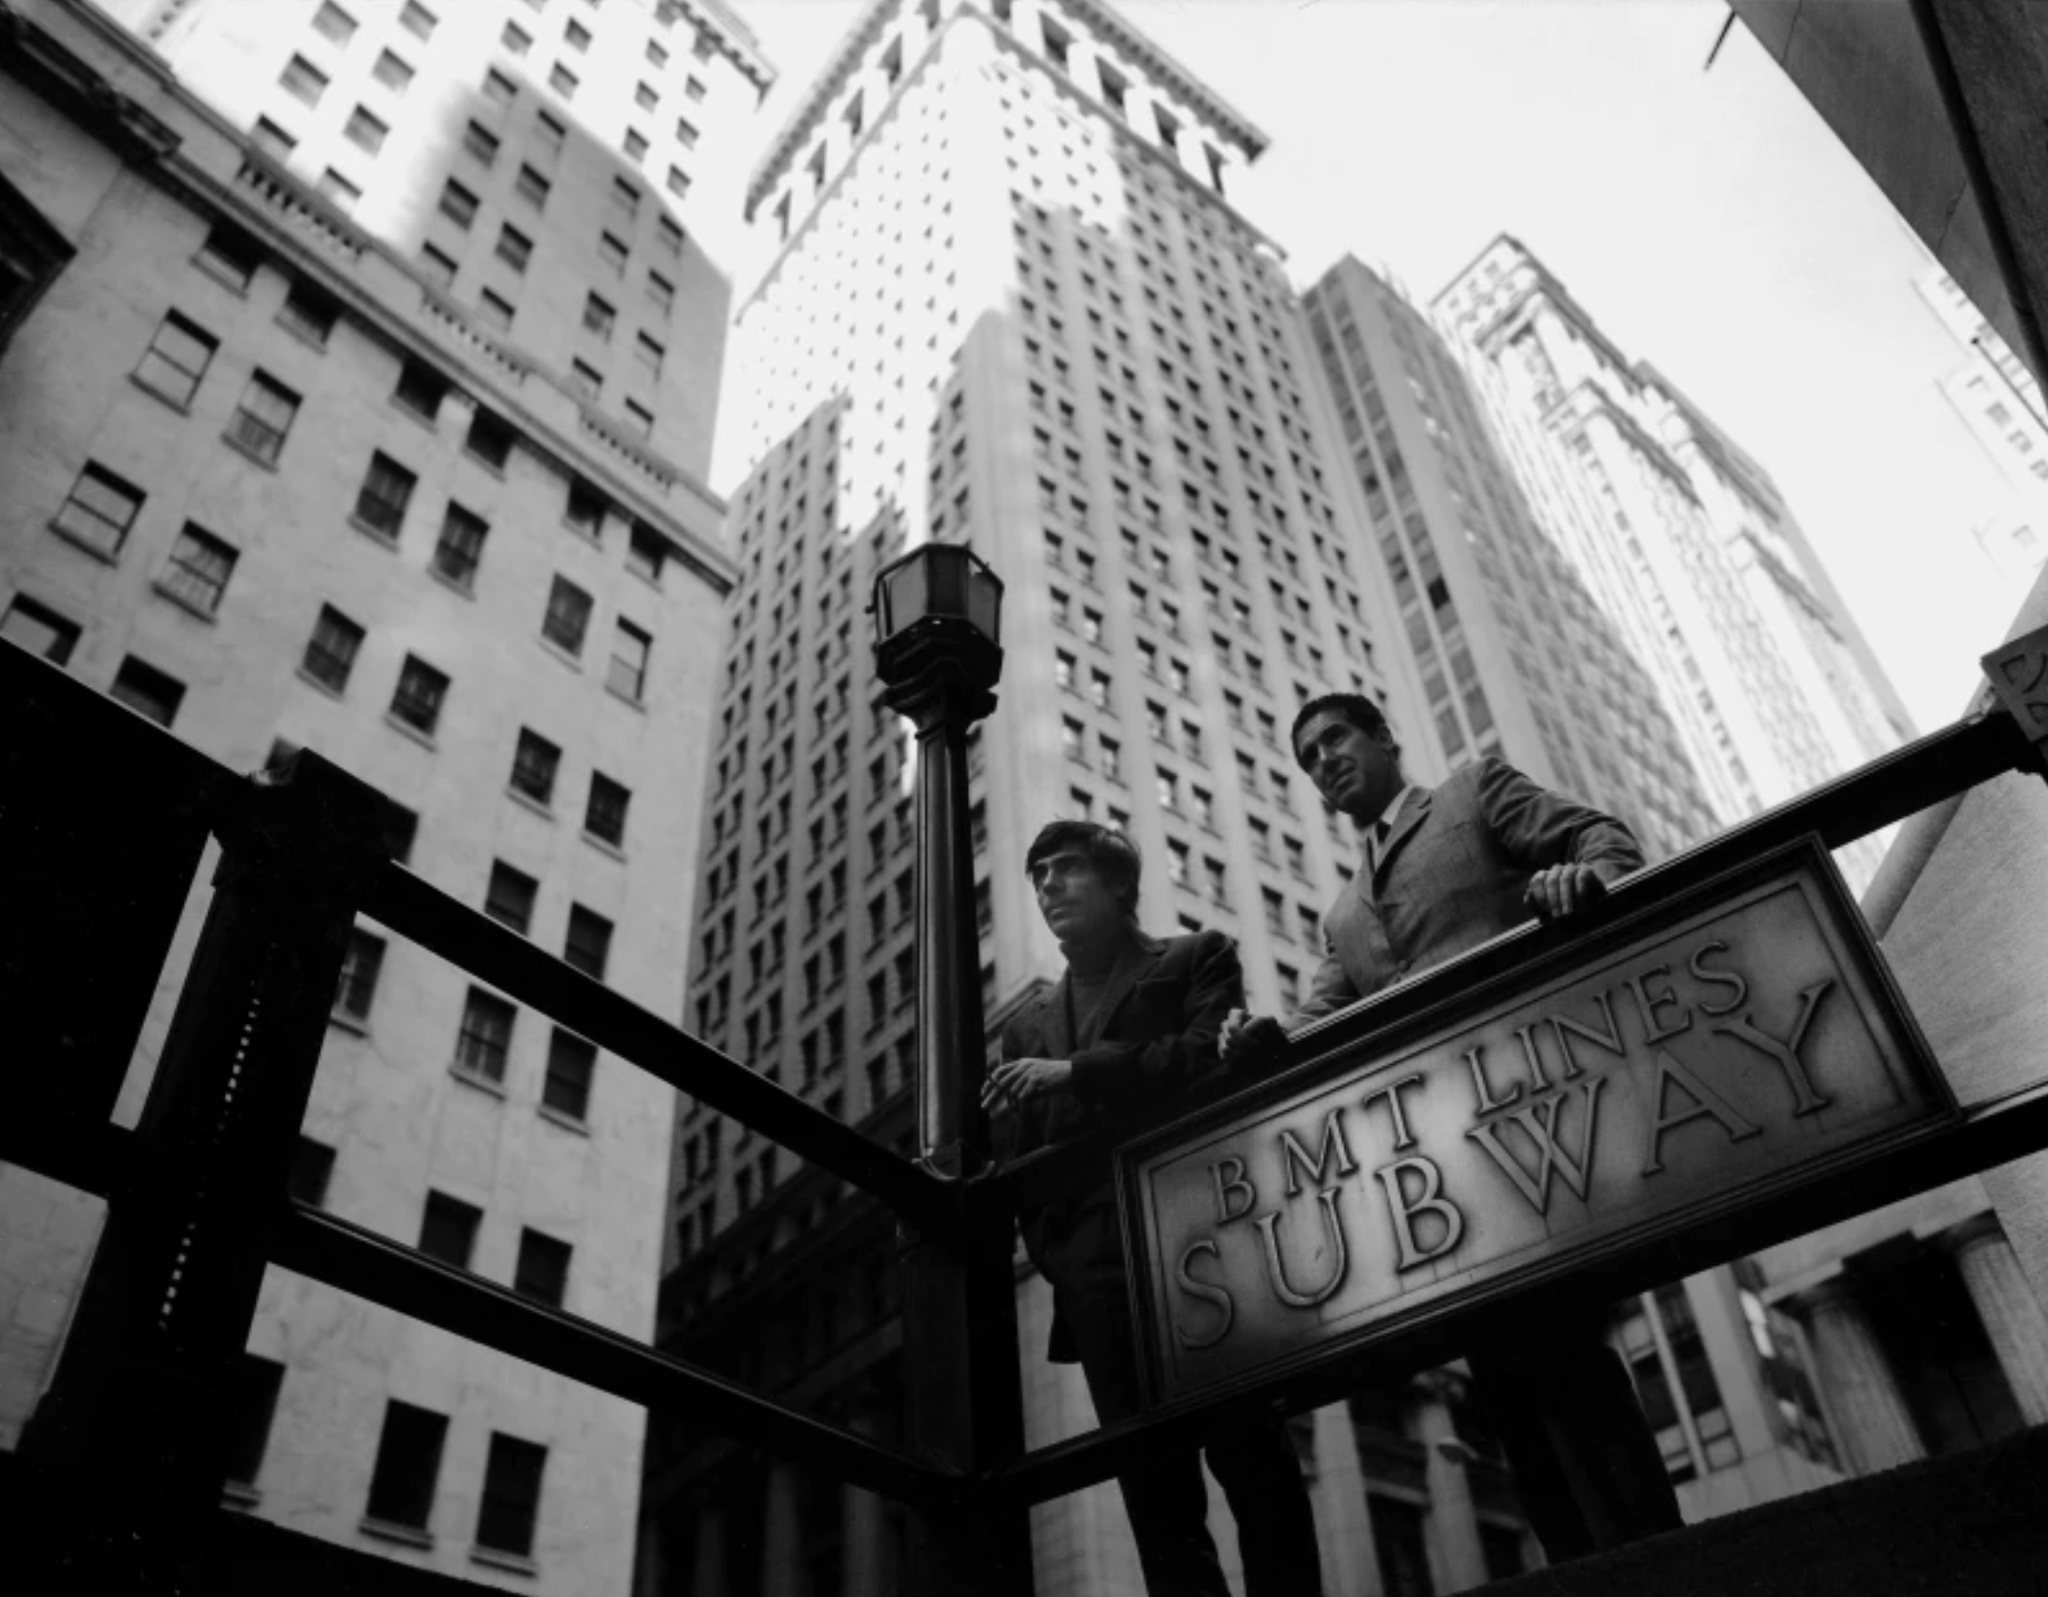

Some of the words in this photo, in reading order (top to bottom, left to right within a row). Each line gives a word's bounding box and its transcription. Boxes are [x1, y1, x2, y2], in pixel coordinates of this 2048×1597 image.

[1174, 978, 1835, 1348] SUBWAY
[1207, 1073, 1425, 1226] BMT
[1463, 940, 1747, 1118] LINES
